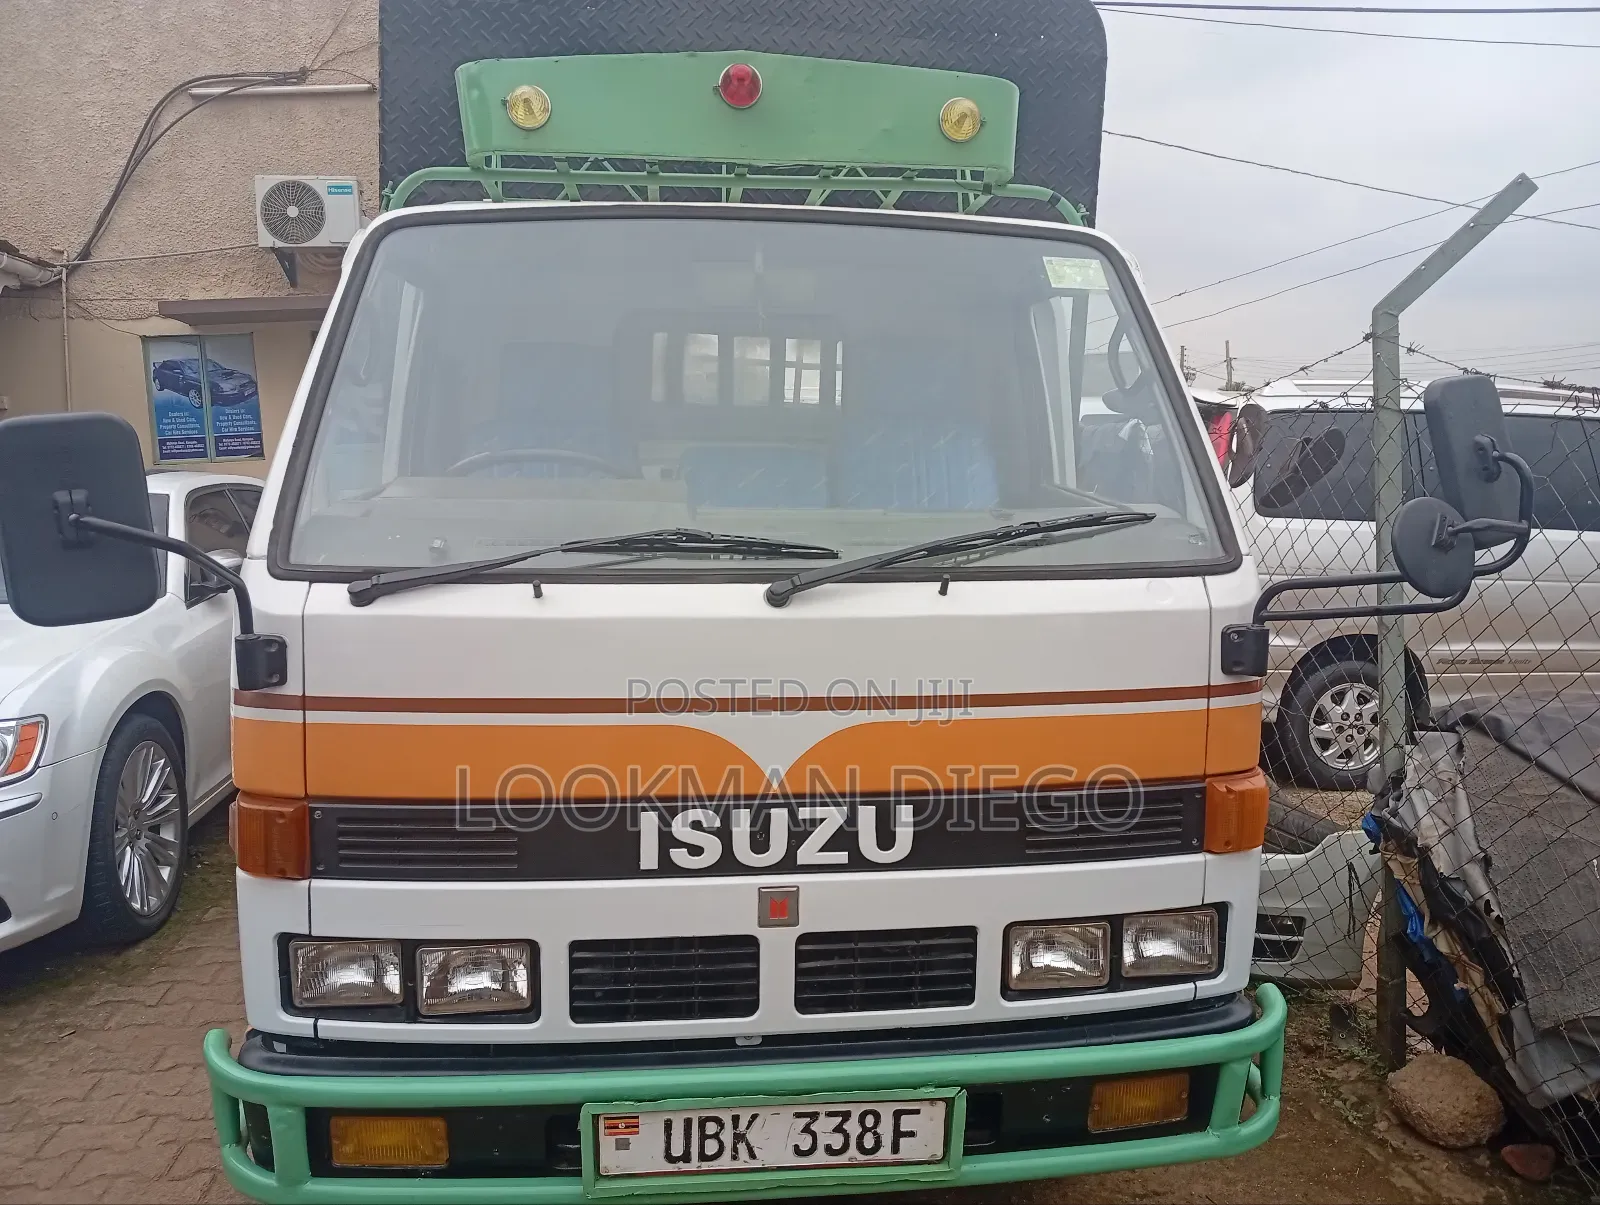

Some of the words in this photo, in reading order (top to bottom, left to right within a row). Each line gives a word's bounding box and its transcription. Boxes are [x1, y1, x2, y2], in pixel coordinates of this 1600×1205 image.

[639, 804, 914, 871] ISUZU
[663, 1112, 760, 1164] UBK
[792, 1108, 922, 1158] 338F
